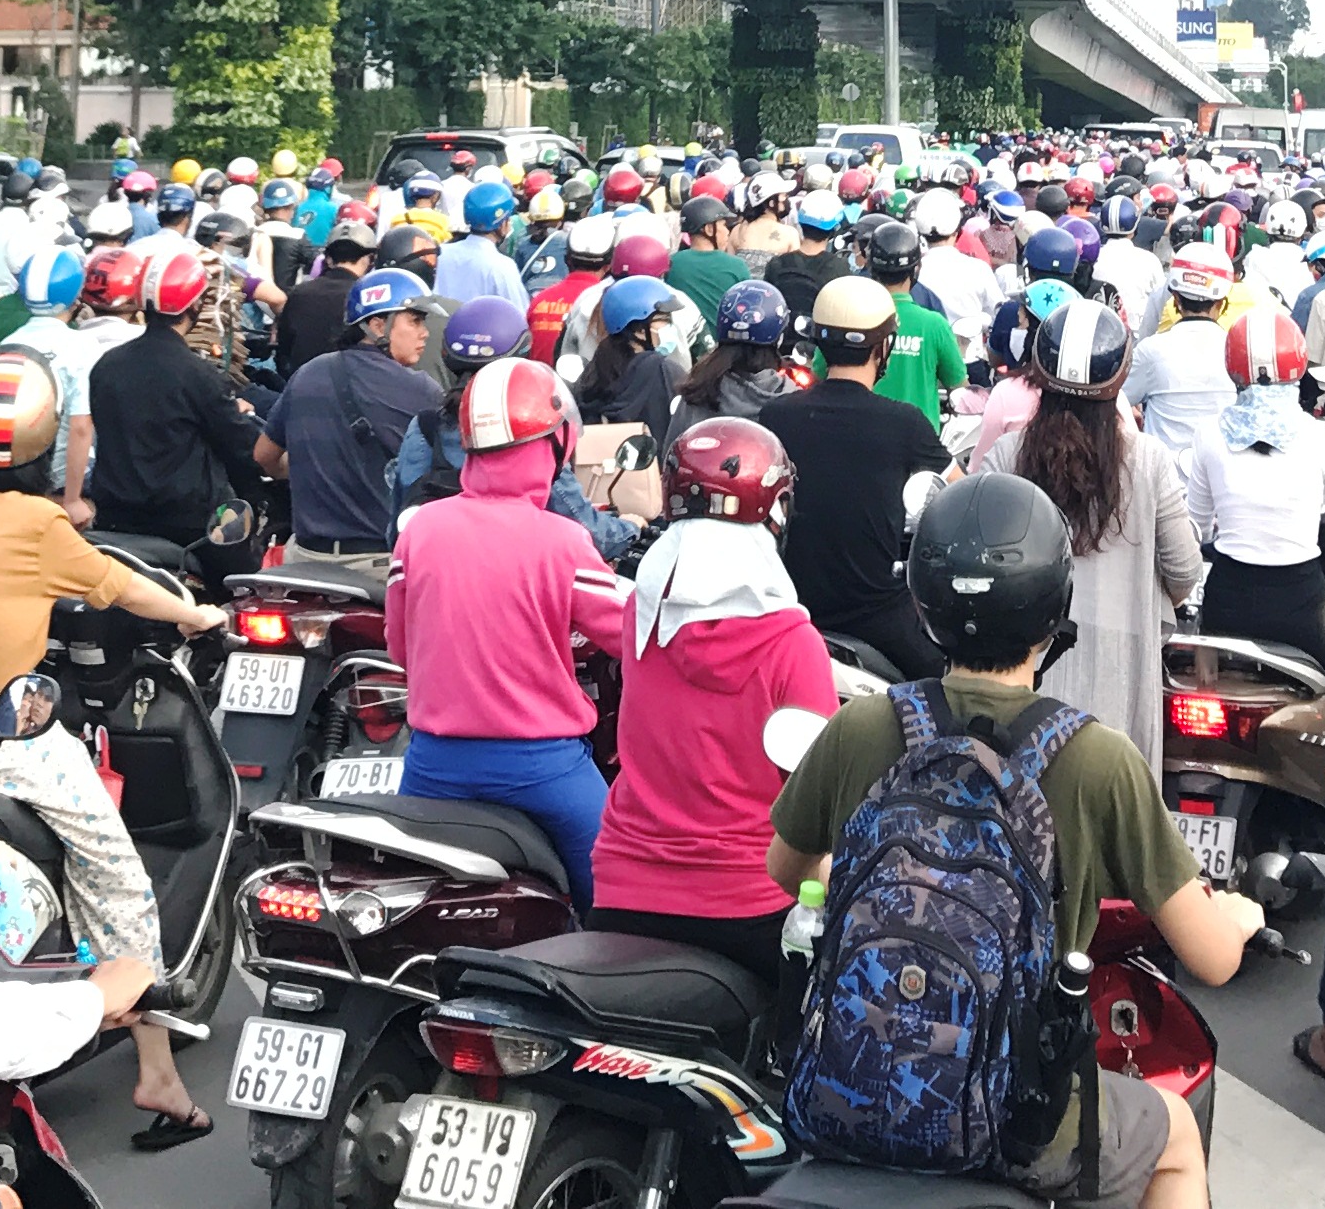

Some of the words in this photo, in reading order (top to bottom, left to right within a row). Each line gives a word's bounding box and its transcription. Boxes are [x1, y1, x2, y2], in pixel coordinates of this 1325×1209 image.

[238, 658, 289, 683] 59-U1
[226, 684, 294, 710] 463.20
[336, 762, 393, 788] 70-B1
[1174, 817, 1220, 846] 9-F1
[438, 906, 499, 920] LEAD
[438, 1007, 475, 1021] HONDA
[256, 1026, 324, 1068] 59-G1
[235, 1065, 327, 1112] 667.29
[431, 1105, 516, 1156] 53-V9
[419, 1152, 503, 1205] 6059
